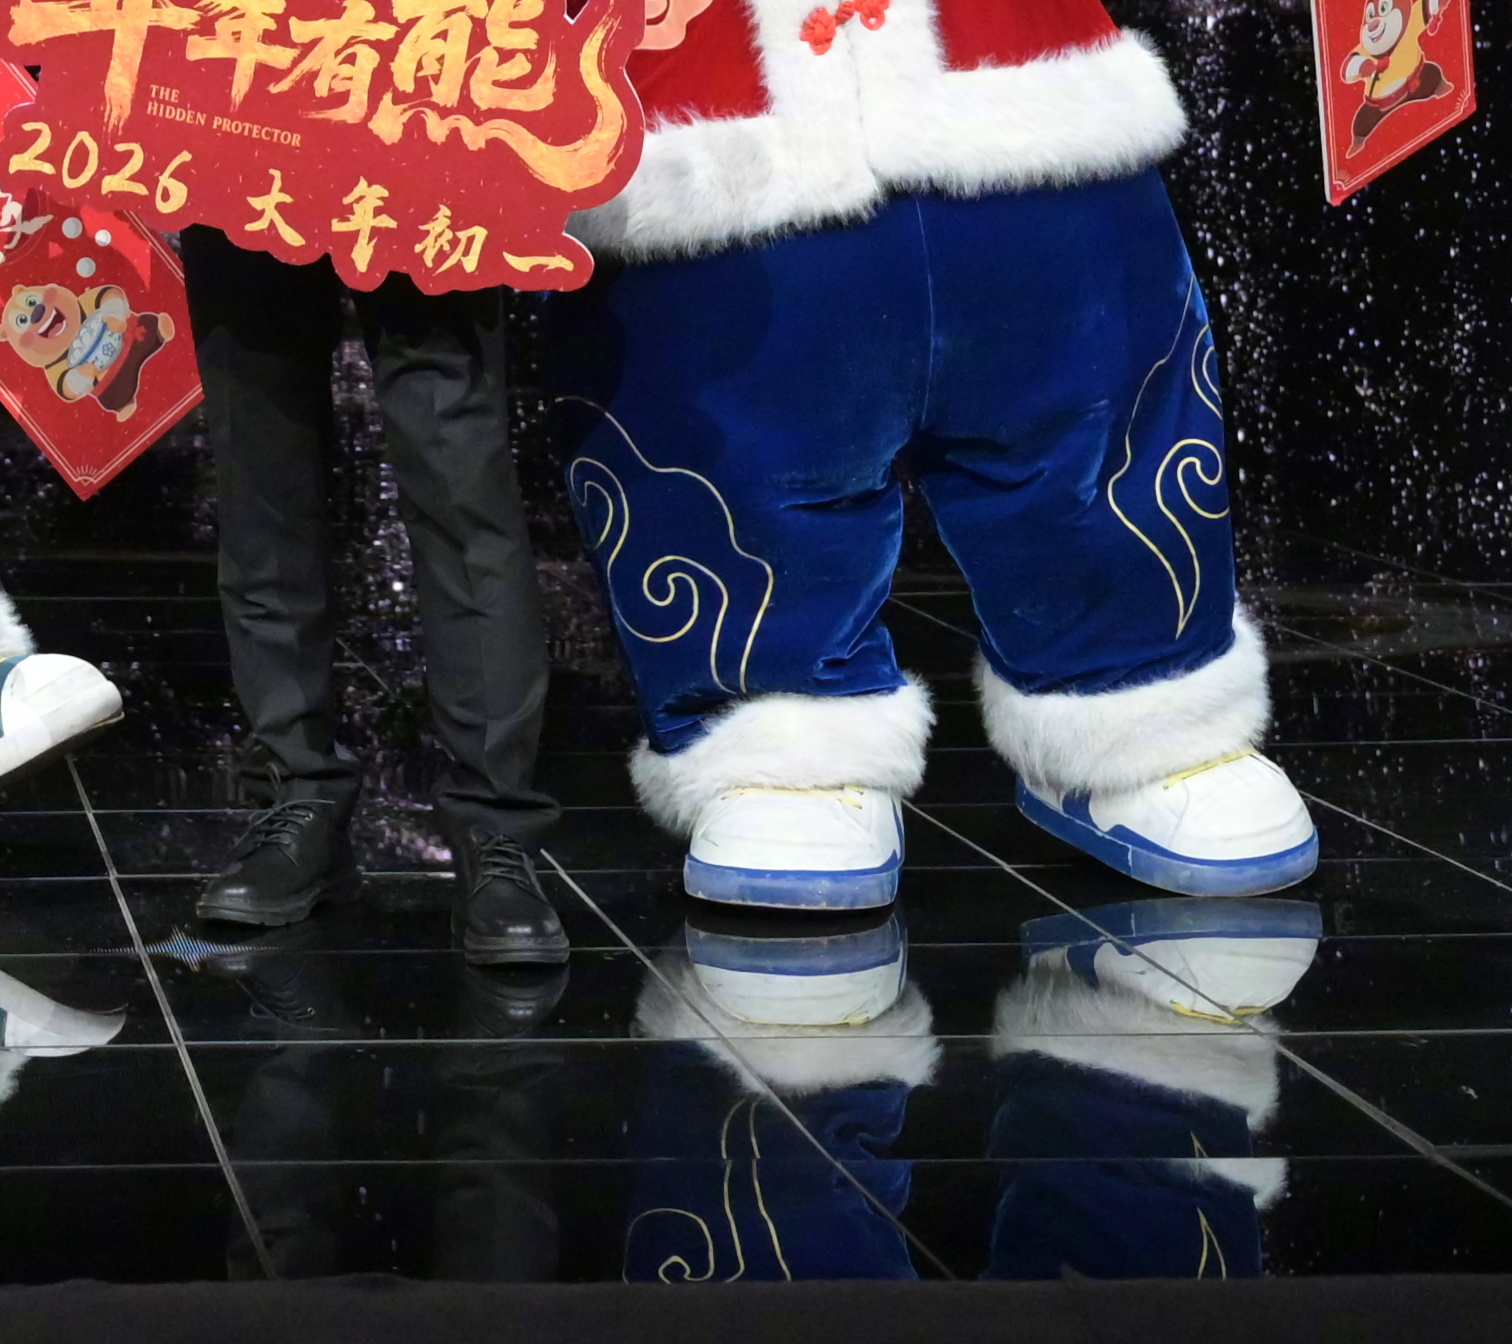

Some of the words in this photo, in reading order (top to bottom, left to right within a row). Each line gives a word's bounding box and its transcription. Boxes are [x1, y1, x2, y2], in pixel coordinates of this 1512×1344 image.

[149, 84, 180, 103] THE
[147, 101, 207, 127] HIDDEN
[212, 116, 302, 147] PROTECTOR
[9, 122, 192, 213] 2026
[245, 168, 575, 274] 大年初一
